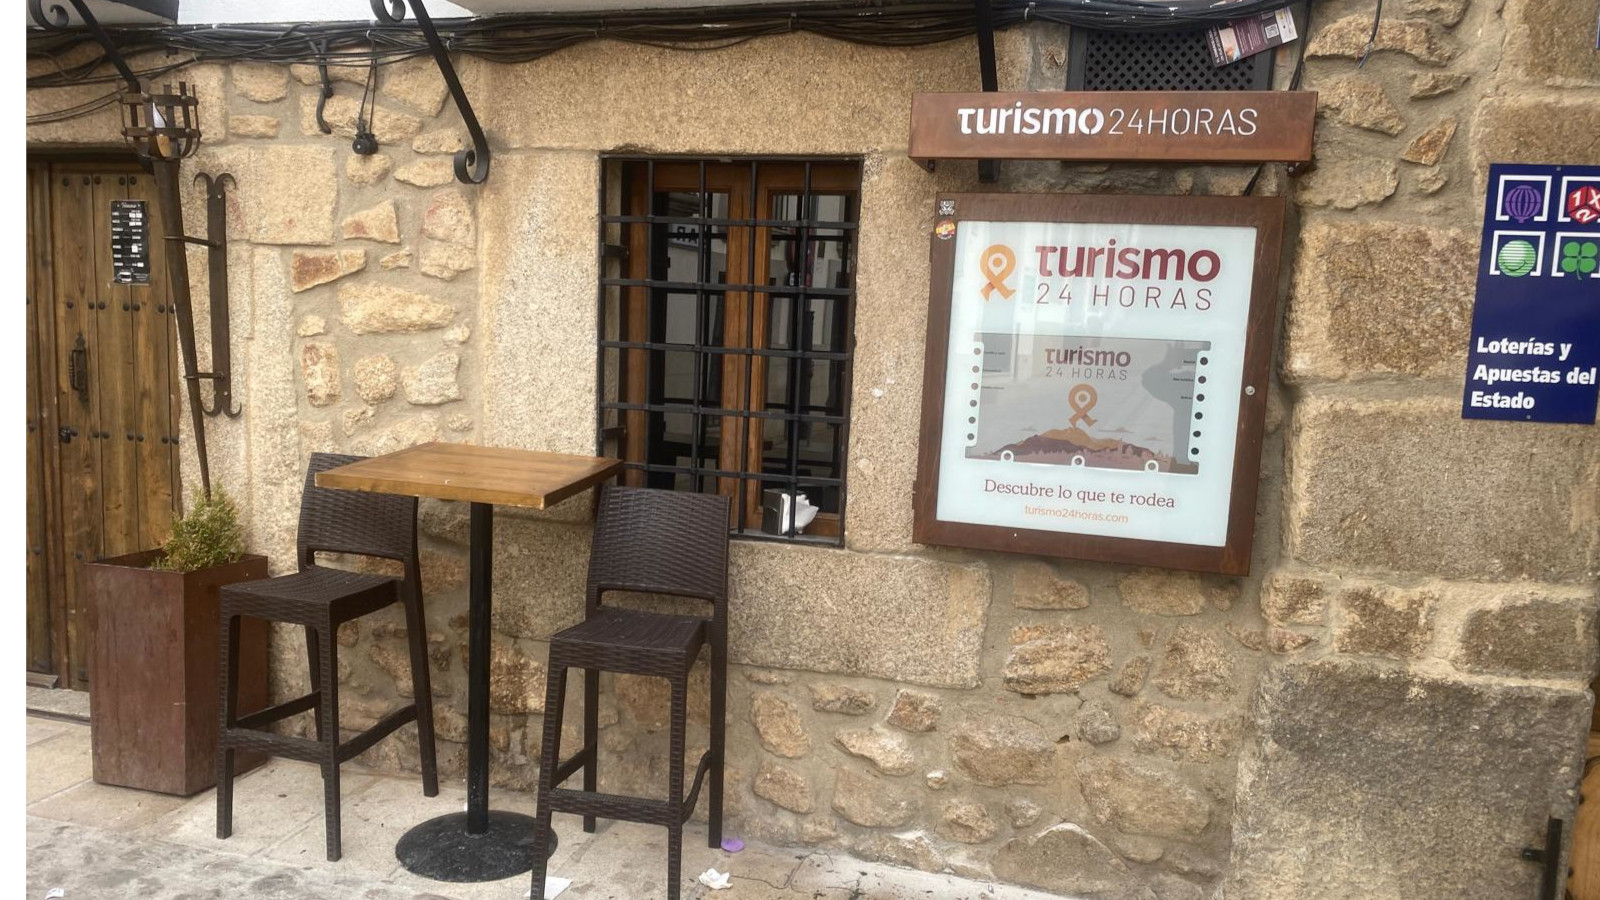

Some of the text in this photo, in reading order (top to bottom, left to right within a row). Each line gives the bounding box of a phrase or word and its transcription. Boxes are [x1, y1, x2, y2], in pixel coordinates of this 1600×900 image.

[957, 101, 1258, 136] turismo 24HORAS
[1035, 238, 1221, 283] turismo
[1036, 282, 1212, 311] 24 HORAS
[1045, 345, 1131, 368] turismo
[1476, 336, 1573, 361] Loterías y
[1045, 366, 1128, 381] 24 HORAS
[1472, 364, 1597, 386] Apuestas del
[1470, 390, 1536, 410] Estado
[984, 479, 1175, 508] Descubre lo que te rodea
[1025, 504, 1129, 523] turismo24horas.com
